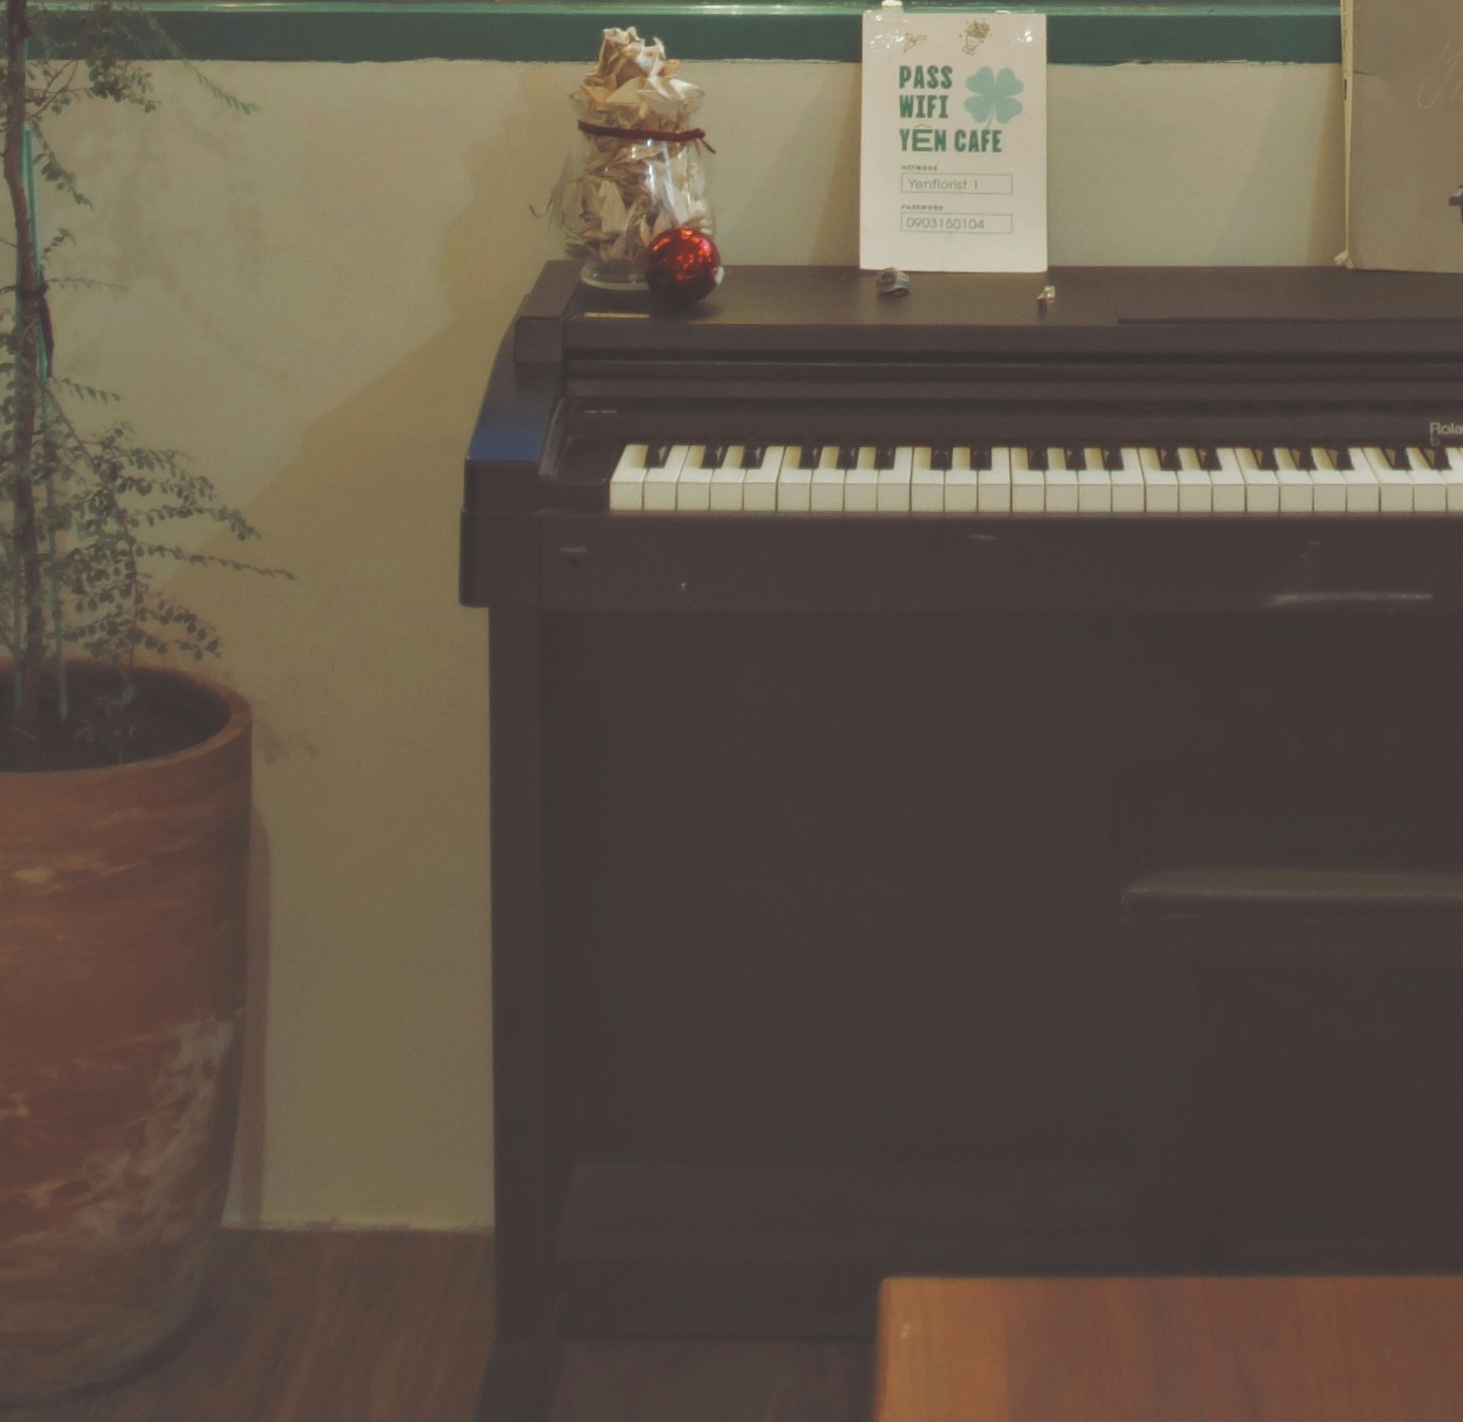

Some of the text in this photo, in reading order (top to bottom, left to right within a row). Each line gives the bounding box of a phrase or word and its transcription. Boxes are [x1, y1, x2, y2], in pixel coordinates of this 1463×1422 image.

[899, 65, 953, 89] PASS
[899, 95, 949, 118] WIFI
[954, 130, 1002, 152] CAFE
[908, 179, 968, 190] Yenflorist
